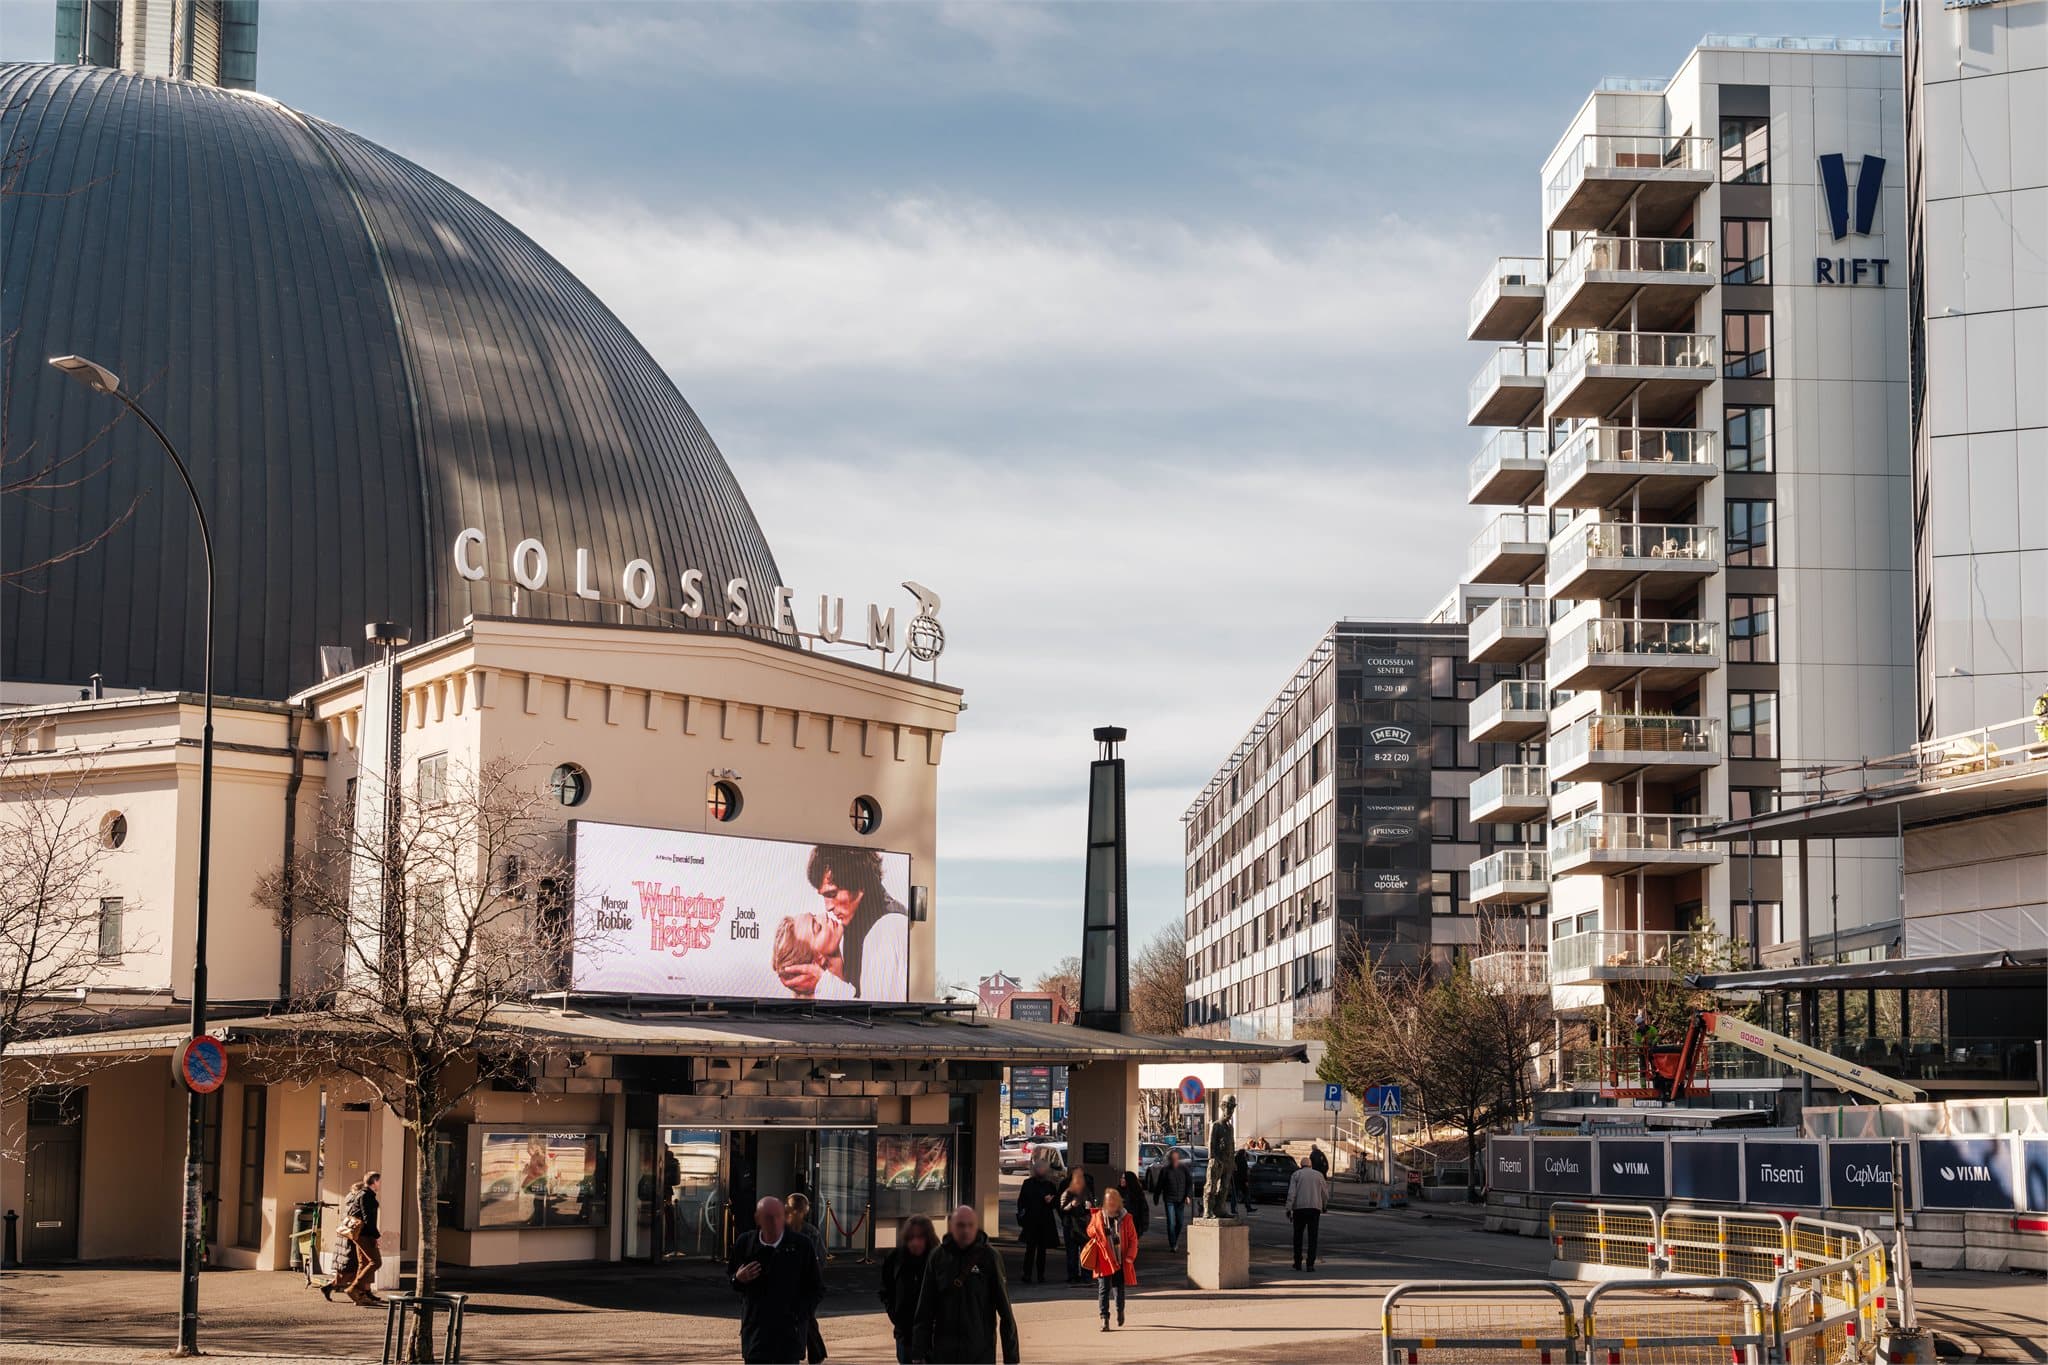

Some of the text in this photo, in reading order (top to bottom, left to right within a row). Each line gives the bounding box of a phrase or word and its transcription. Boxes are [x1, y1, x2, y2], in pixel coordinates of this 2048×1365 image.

[1816, 257, 1889, 285] RIFT
[454, 527, 894, 653] COLOSSEUM
[1367, 658, 1414, 666] COLOSSEUM
[1375, 730, 1407, 739] MENY
[1374, 753, 1409, 762] 8-22 (20)
[601, 895, 628, 912] Margot
[597, 910, 632, 931] Robbie
[735, 907, 756, 920] Jacob
[730, 921, 760, 940] Elordi
[1329, 1085, 1338, 1099] P
[1545, 1157, 1579, 1175] CapMan
[1624, 1162, 1650, 1175] VISMA
[1761, 1164, 1804, 1184] insenti
[1956, 1166, 1992, 1181] VISMA
[1845, 1164, 1893, 1187] CapMan
